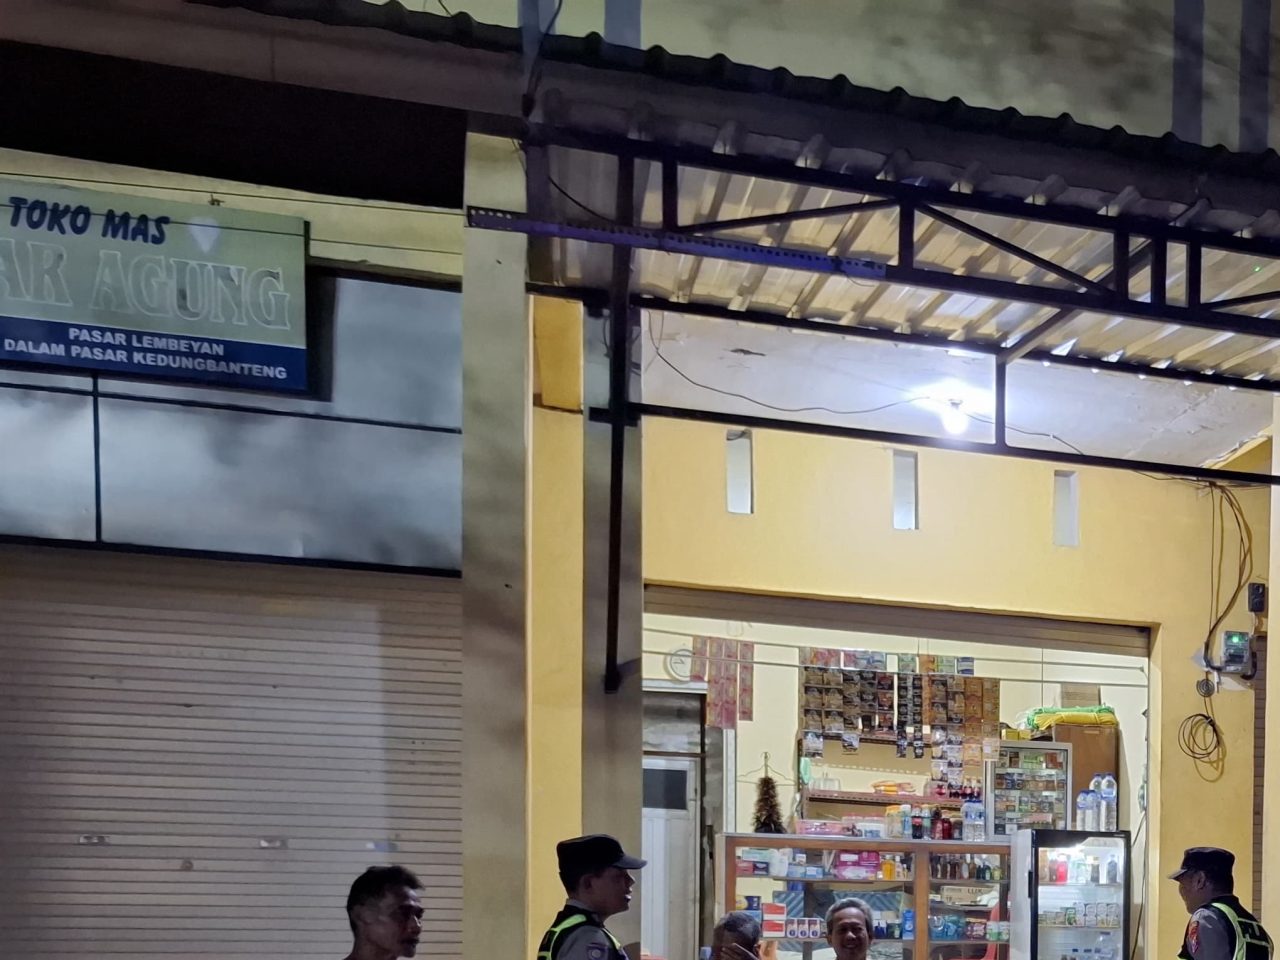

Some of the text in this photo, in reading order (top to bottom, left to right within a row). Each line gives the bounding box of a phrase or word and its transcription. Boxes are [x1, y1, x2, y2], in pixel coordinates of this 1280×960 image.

[9, 196, 171, 245] TOKO MAS
[89, 250, 291, 331] AGUNG
[4, 338, 288, 380] DALAM PASAR KEDUNGBANTENG
[68, 327, 225, 357] PASAR LEMBEYAN
